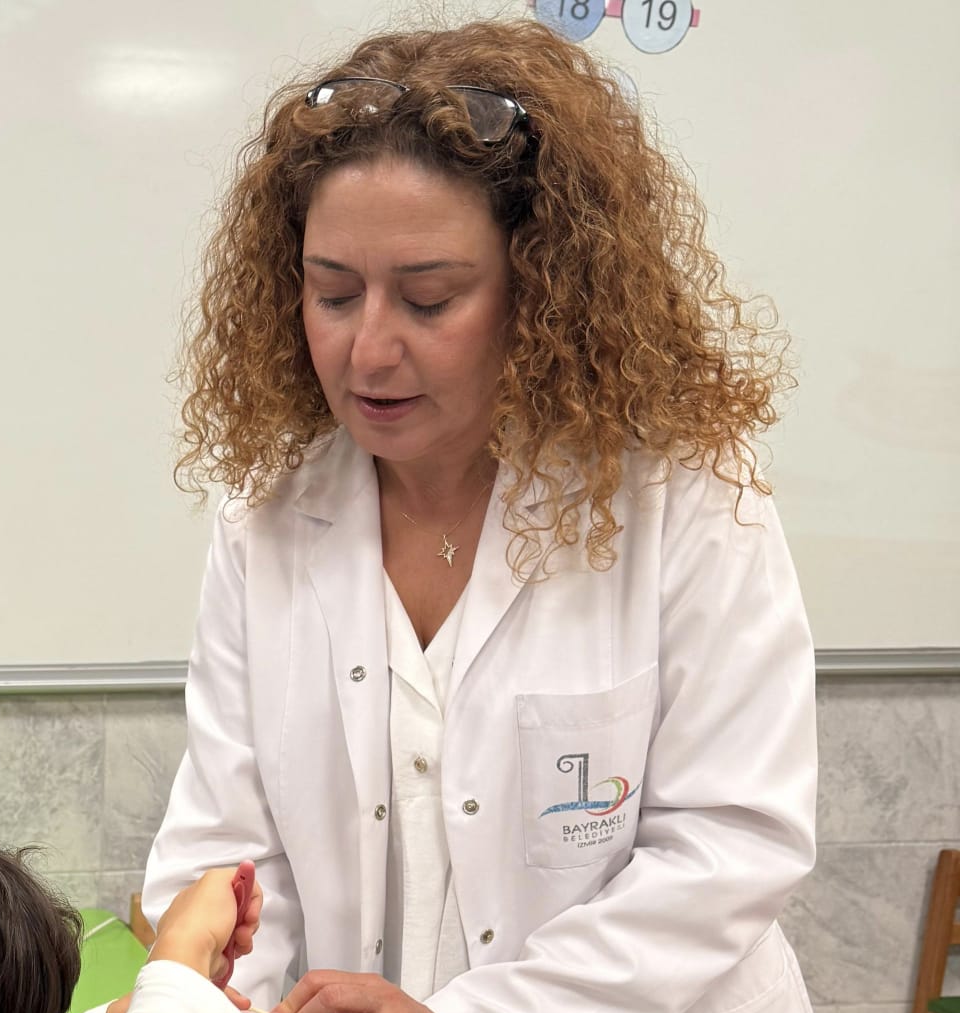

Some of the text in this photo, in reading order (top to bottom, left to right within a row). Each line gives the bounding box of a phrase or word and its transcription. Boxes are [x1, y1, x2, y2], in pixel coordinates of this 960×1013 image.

[558, 0, 589, 20] 18
[642, 0, 677, 31] 19
[562, 812, 626, 835] BAYRAKLI
